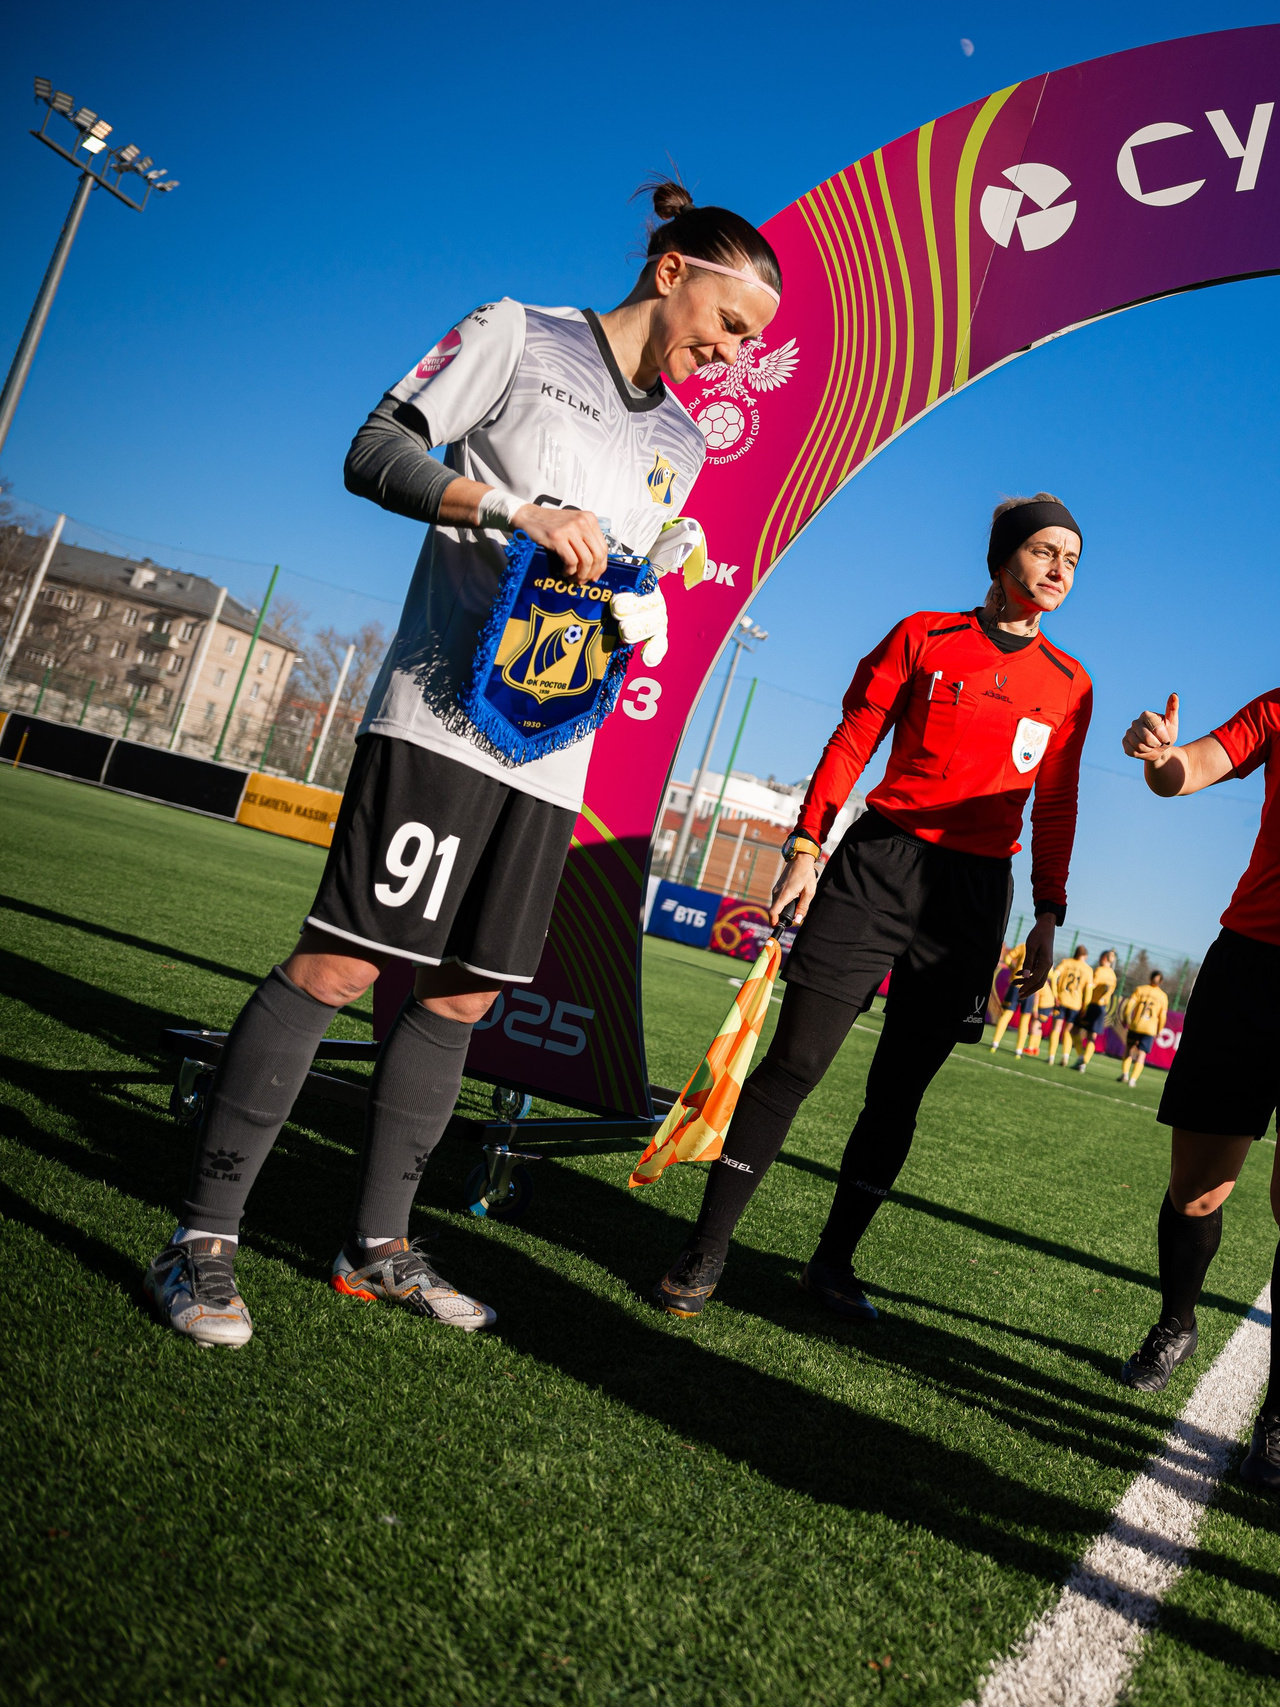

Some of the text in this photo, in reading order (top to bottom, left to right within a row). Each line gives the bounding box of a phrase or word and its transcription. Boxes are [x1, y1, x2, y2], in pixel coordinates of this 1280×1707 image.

[421, 357, 446, 366] СУПЕР
[540, 382, 601, 422] KELME
[750, 409, 760, 436] СОЮЗ
[534, 578, 614, 602] «РОСТОВ
[526, 678, 568, 690] ФК РОСТОВ
[981, 690, 1013, 704] JÖGEL
[523, 720, 542, 729] 1930
[374, 821, 461, 922] 91
[673, 905, 708, 928] ВТБ
[718, 1153, 754, 1174] ÖGEL
[199, 1167, 242, 1182] KELME
